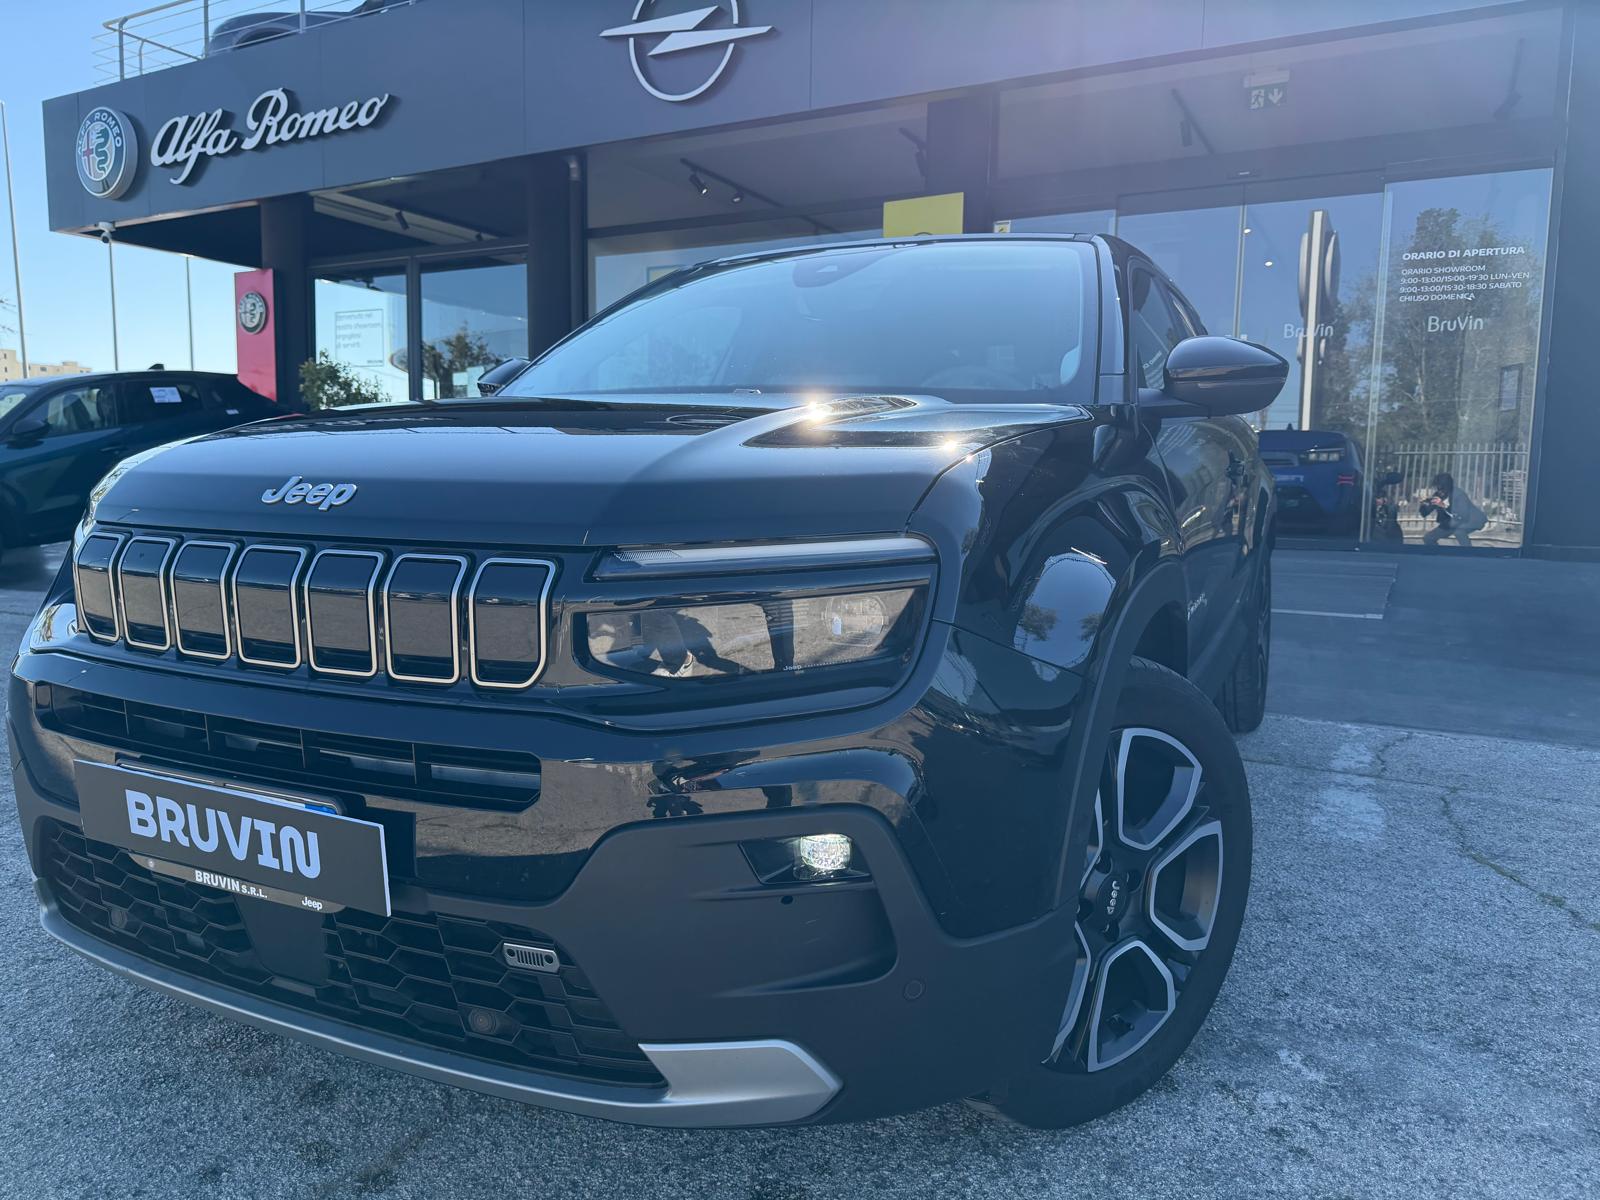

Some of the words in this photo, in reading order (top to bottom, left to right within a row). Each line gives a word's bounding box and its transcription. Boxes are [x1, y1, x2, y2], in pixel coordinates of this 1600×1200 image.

[94, 112, 122, 148] ROMEO
[151, 107, 237, 185] Alfa
[241, 87, 389, 150] Romeo
[1402, 251, 1446, 260] ORARIO
[1448, 250, 1460, 258] DI
[1462, 246, 1525, 257] APERTURA
[1401, 267, 1432, 275] ORARIO
[1433, 265, 1486, 273] SHOWROOM
[1490, 272, 1530, 280] LUN-VEN
[1488, 281, 1522, 290] SABATO
[1399, 294, 1430, 302] CHIUSO
[1427, 315, 1484, 332] BruVin
[261, 475, 357, 511] Jeep
[125, 789, 321, 879] BRUVIN
[194, 869, 240, 892] BRUVIN
[241, 884, 268, 899] S.R.L.
[301, 896, 323, 911] Jeep
[1106, 880, 1120, 915] Jeep
